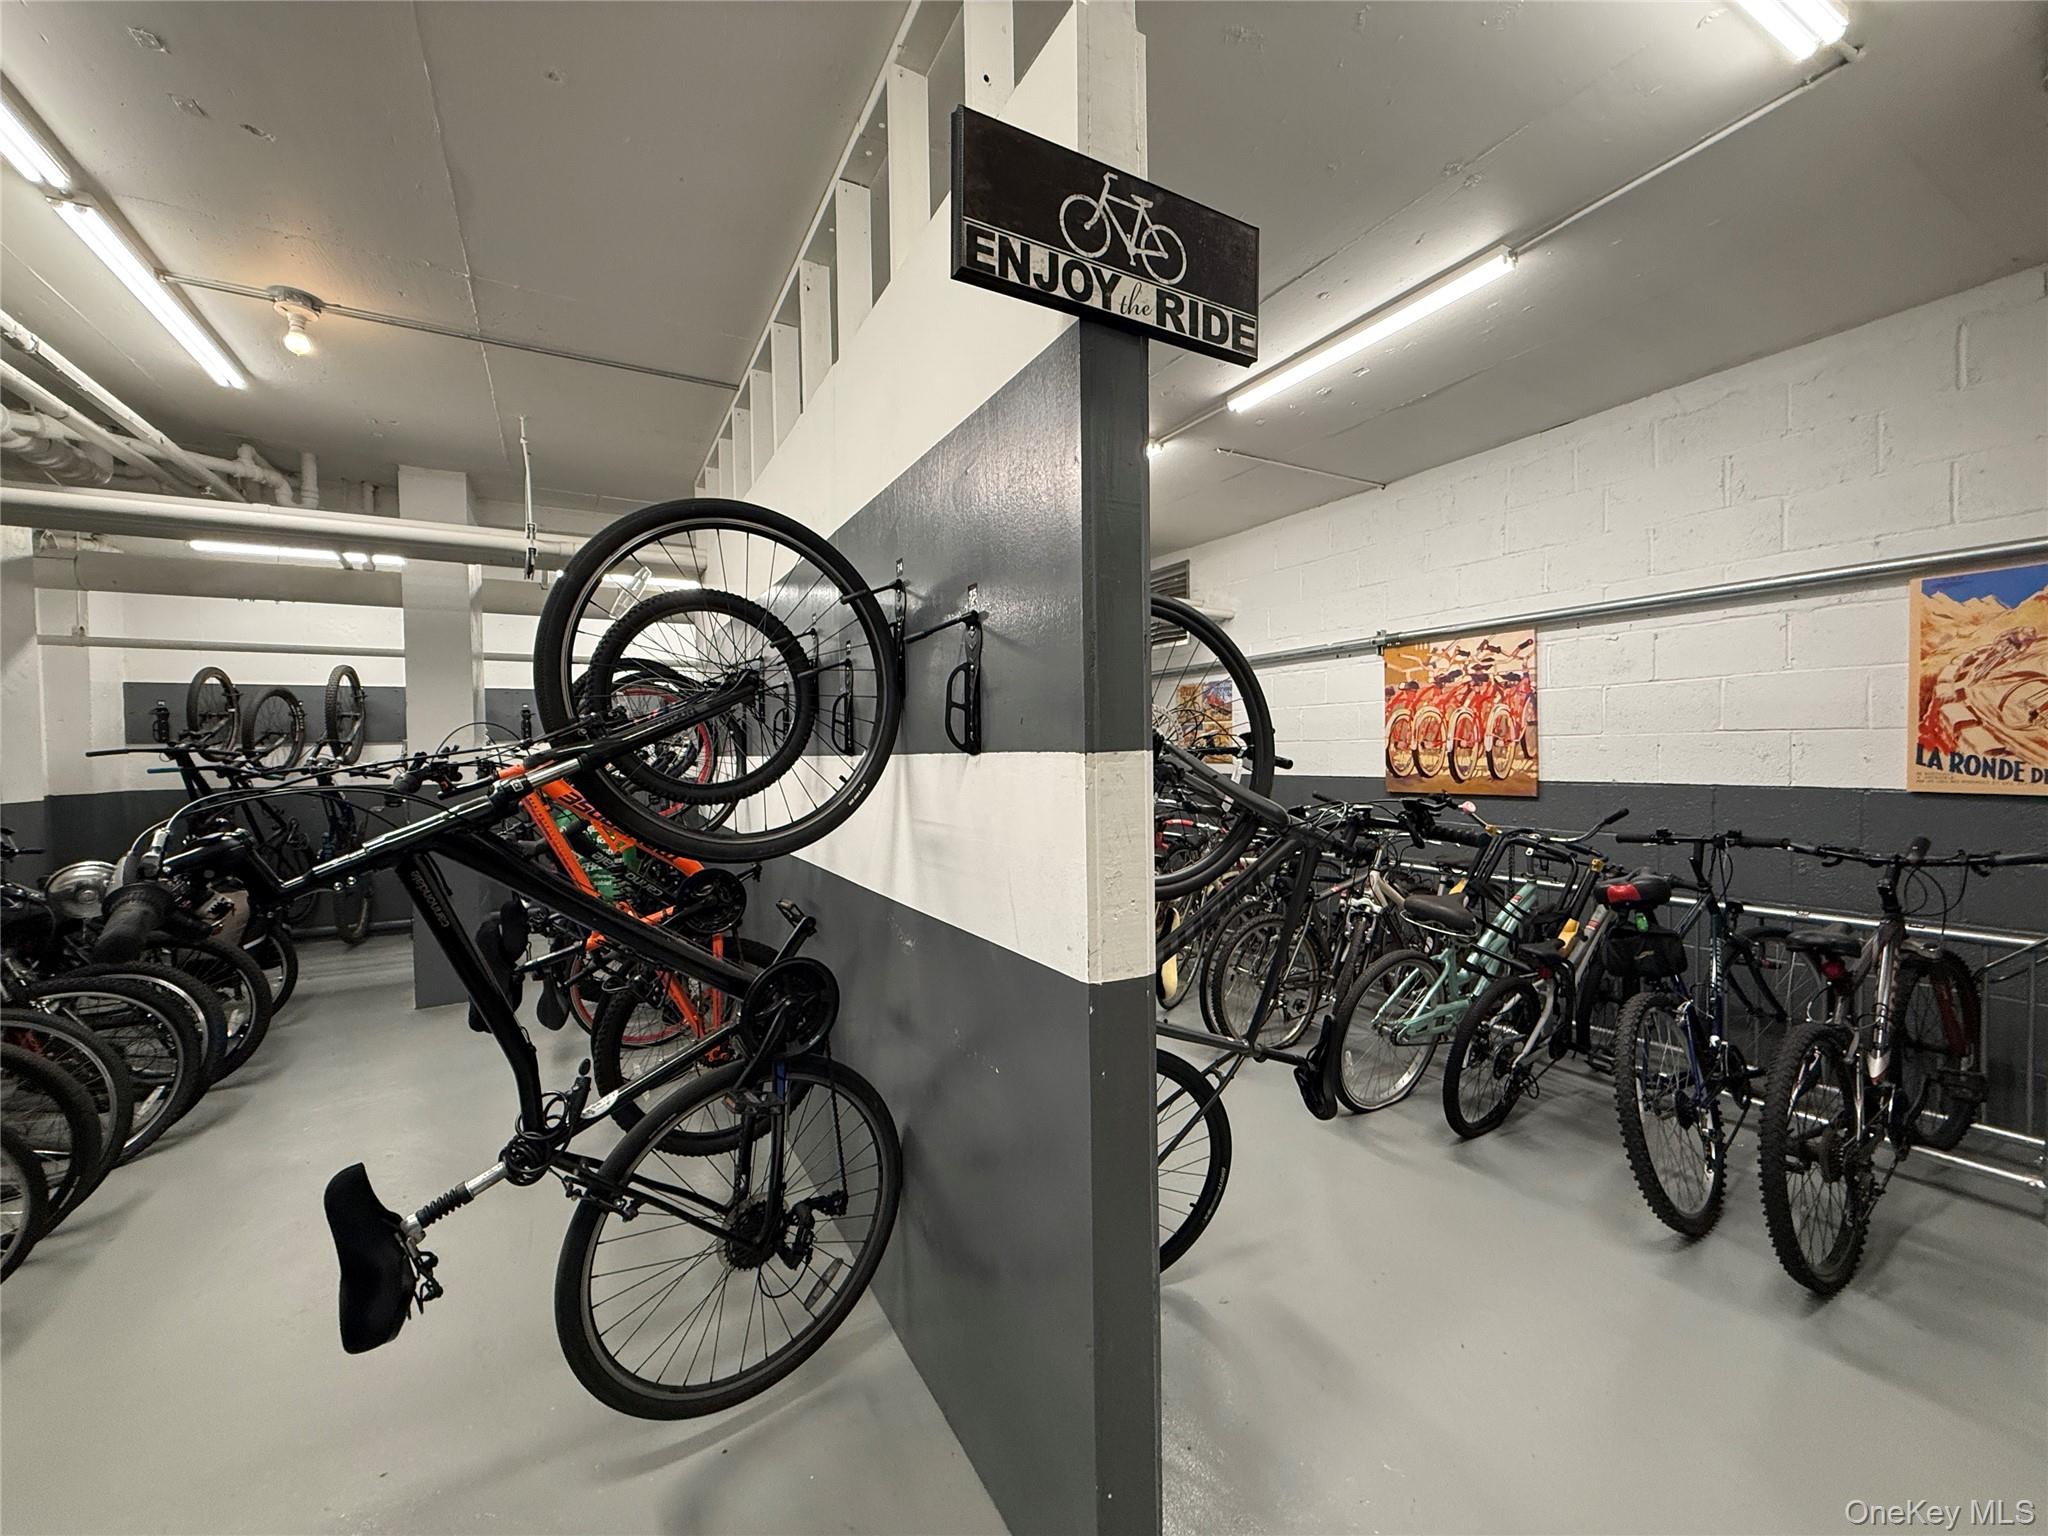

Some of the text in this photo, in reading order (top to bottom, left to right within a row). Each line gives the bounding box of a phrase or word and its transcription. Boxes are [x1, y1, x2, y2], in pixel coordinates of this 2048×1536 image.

[966, 224, 1257, 351] ENJOY the RIDE
[1915, 743, 1943, 770] LA
[1949, 751, 2025, 783] RONDE
[591, 851, 663, 897] cannoale
